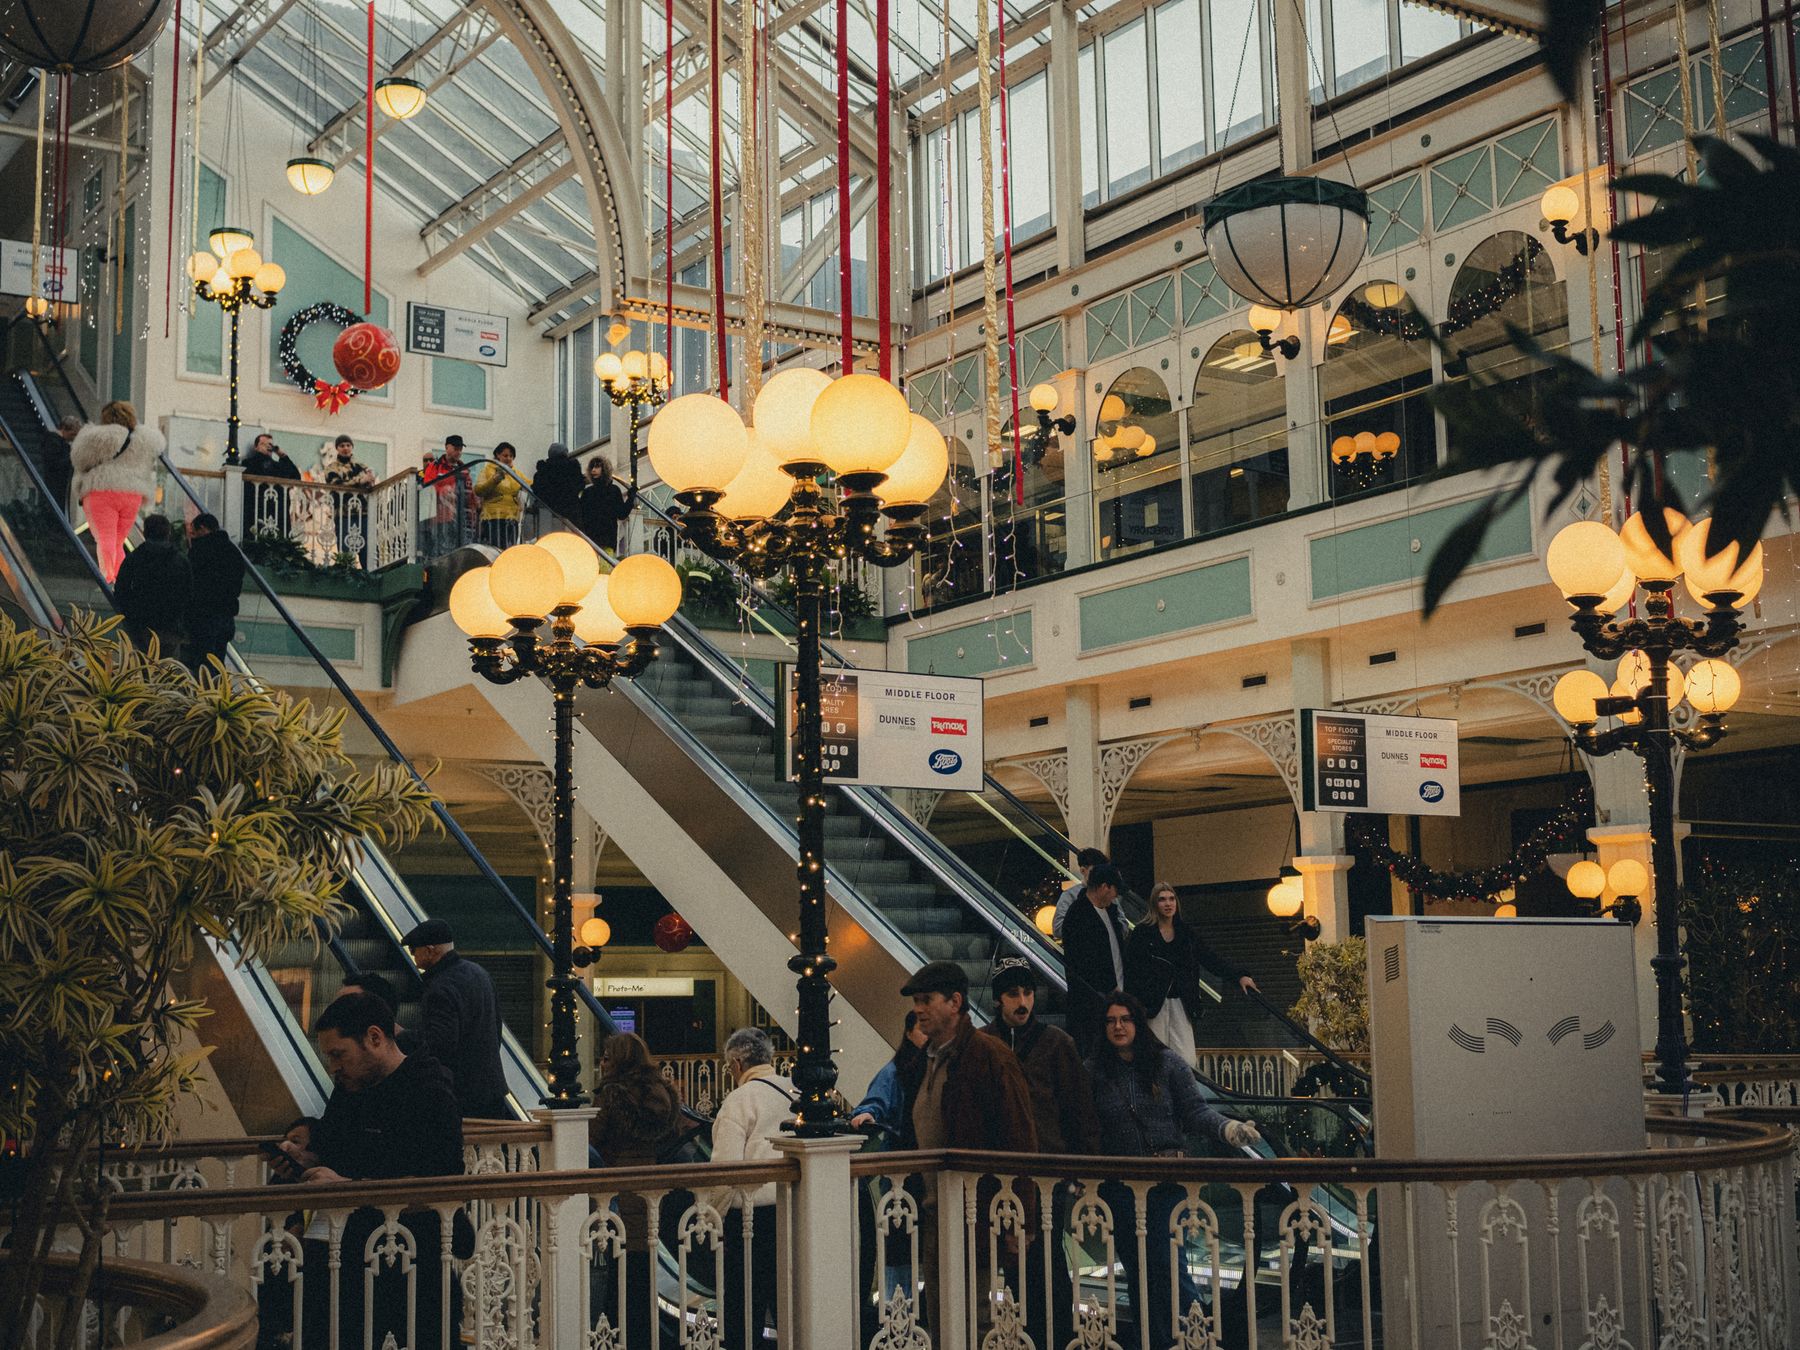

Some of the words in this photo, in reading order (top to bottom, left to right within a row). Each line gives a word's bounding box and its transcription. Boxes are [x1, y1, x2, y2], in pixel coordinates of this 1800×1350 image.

[885, 688, 922, 699] MIDDLE
[925, 691, 956, 701] FLOOR
[879, 714, 916, 726] DUNNES
[1324, 725, 1337, 733] TOP
[1338, 726, 1359, 735] FLOOR
[1385, 729, 1413, 738] MIDDLE
[1415, 731, 1438, 740] FLOOR
[1327, 738, 1357, 746] SPECIALITY
[1381, 751, 1409, 761] DUNNES
